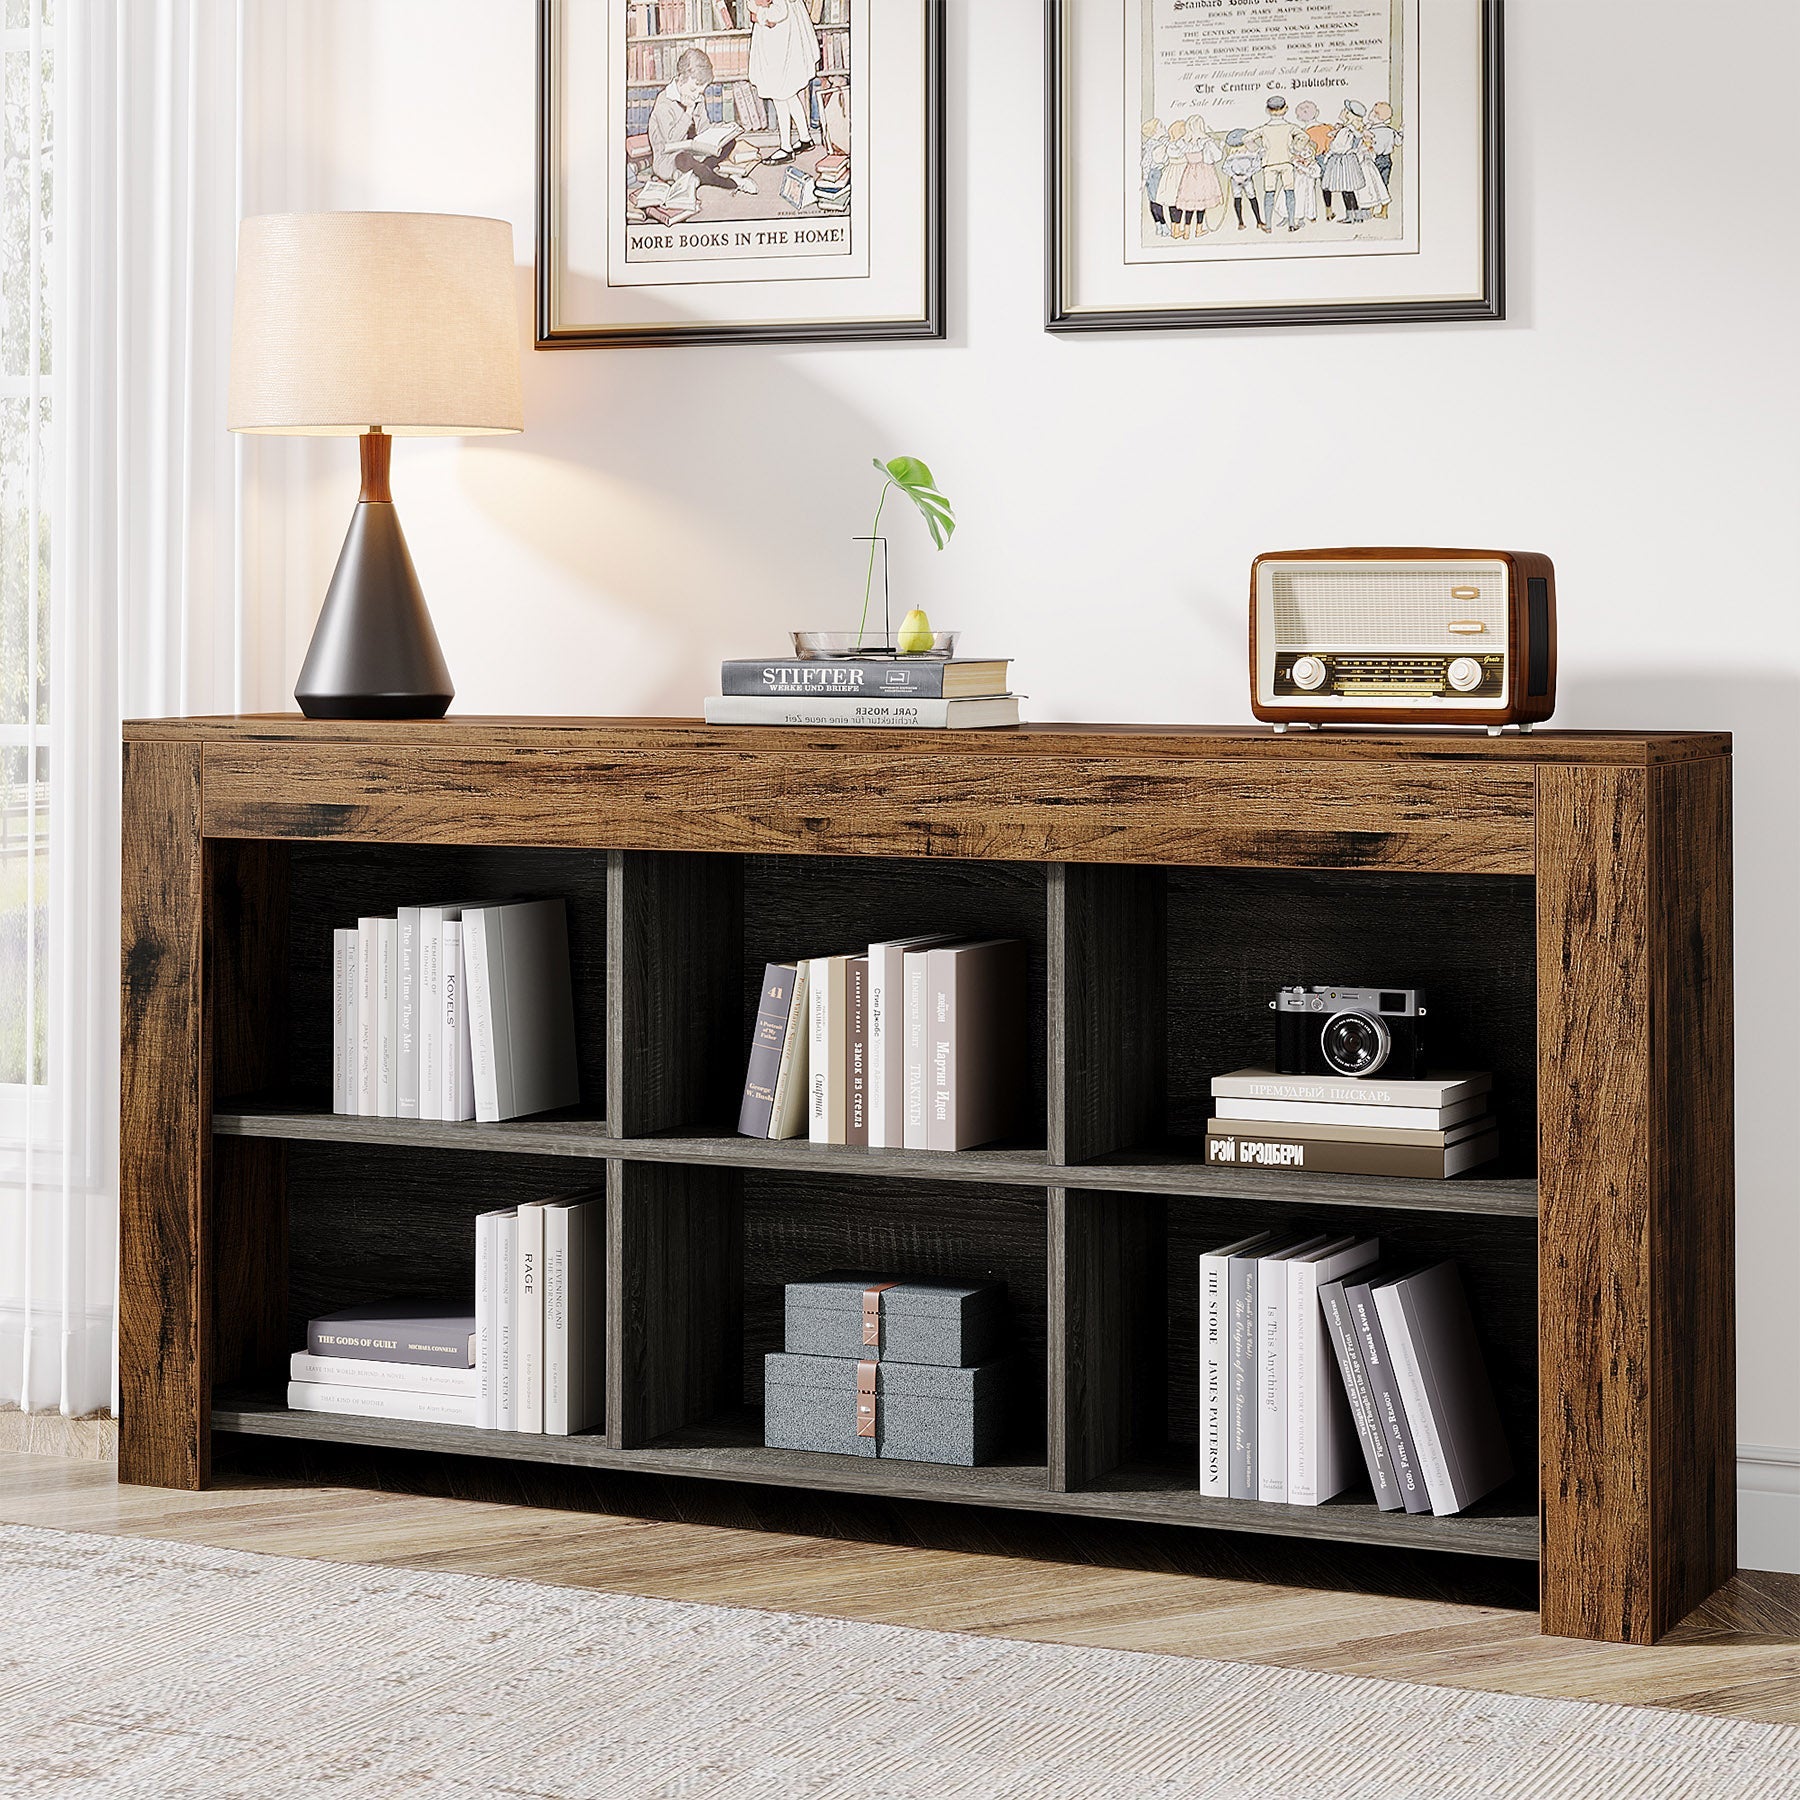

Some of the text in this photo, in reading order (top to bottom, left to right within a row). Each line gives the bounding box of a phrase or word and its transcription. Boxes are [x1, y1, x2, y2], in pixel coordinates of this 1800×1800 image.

[1211, 68, 1257, 79] Illustrated
[1278, 66, 1299, 74] Sold
[1194, 84, 1214, 94] The
[1221, 83, 1261, 92] Century
[1170, 100, 1186, 108] For
[631, 228, 844, 250] MORE BOOKS IN THE HOME!
[763, 668, 864, 685] STIFTER
[401, 925, 412, 1053] The Last Time They Met
[768, 987, 782, 999] 41
[873, 1010, 881, 1037] Джобс
[911, 1024, 921, 1048] Кант
[749, 1083, 772, 1093] George
[933, 1042, 949, 1120] Мартин Иден
[1250, 1085, 1390, 1101] ПРЕМУДРЫЙ ПИСКАРЬ
[756, 1091, 774, 1102] Bush
[812, 1073, 825, 1119] Спартак
[910, 1064, 920, 1126] ТРАКТАТЫ
[1210, 1137, 1304, 1166] РЭЙ БРЭДБЕРИ
[524, 1254, 533, 1294] RAGE
[1235, 1300, 1244, 1318] The
[1331, 1300, 1341, 1326] Cochran
[318, 1335, 397, 1349] THE GODS OF GUILT
[432, 1345, 457, 1353] CONNELLY
[1233, 1322, 1244, 1357] Origins
[1345, 1334, 1354, 1351] Print
[1233, 1360, 1244, 1371] of
[1266, 1305, 1277, 1413] Is This Anything?
[1208, 1270, 1218, 1484] THE STORE JAMES PATTERSON
[1343, 1360, 1353, 1386] Literary
[1362, 1395, 1374, 1423] Thought
[1356, 1408, 1367, 1436] Twilight
[1373, 1432, 1384, 1457] Figures
[1378, 1471, 1386, 1488] Terry
